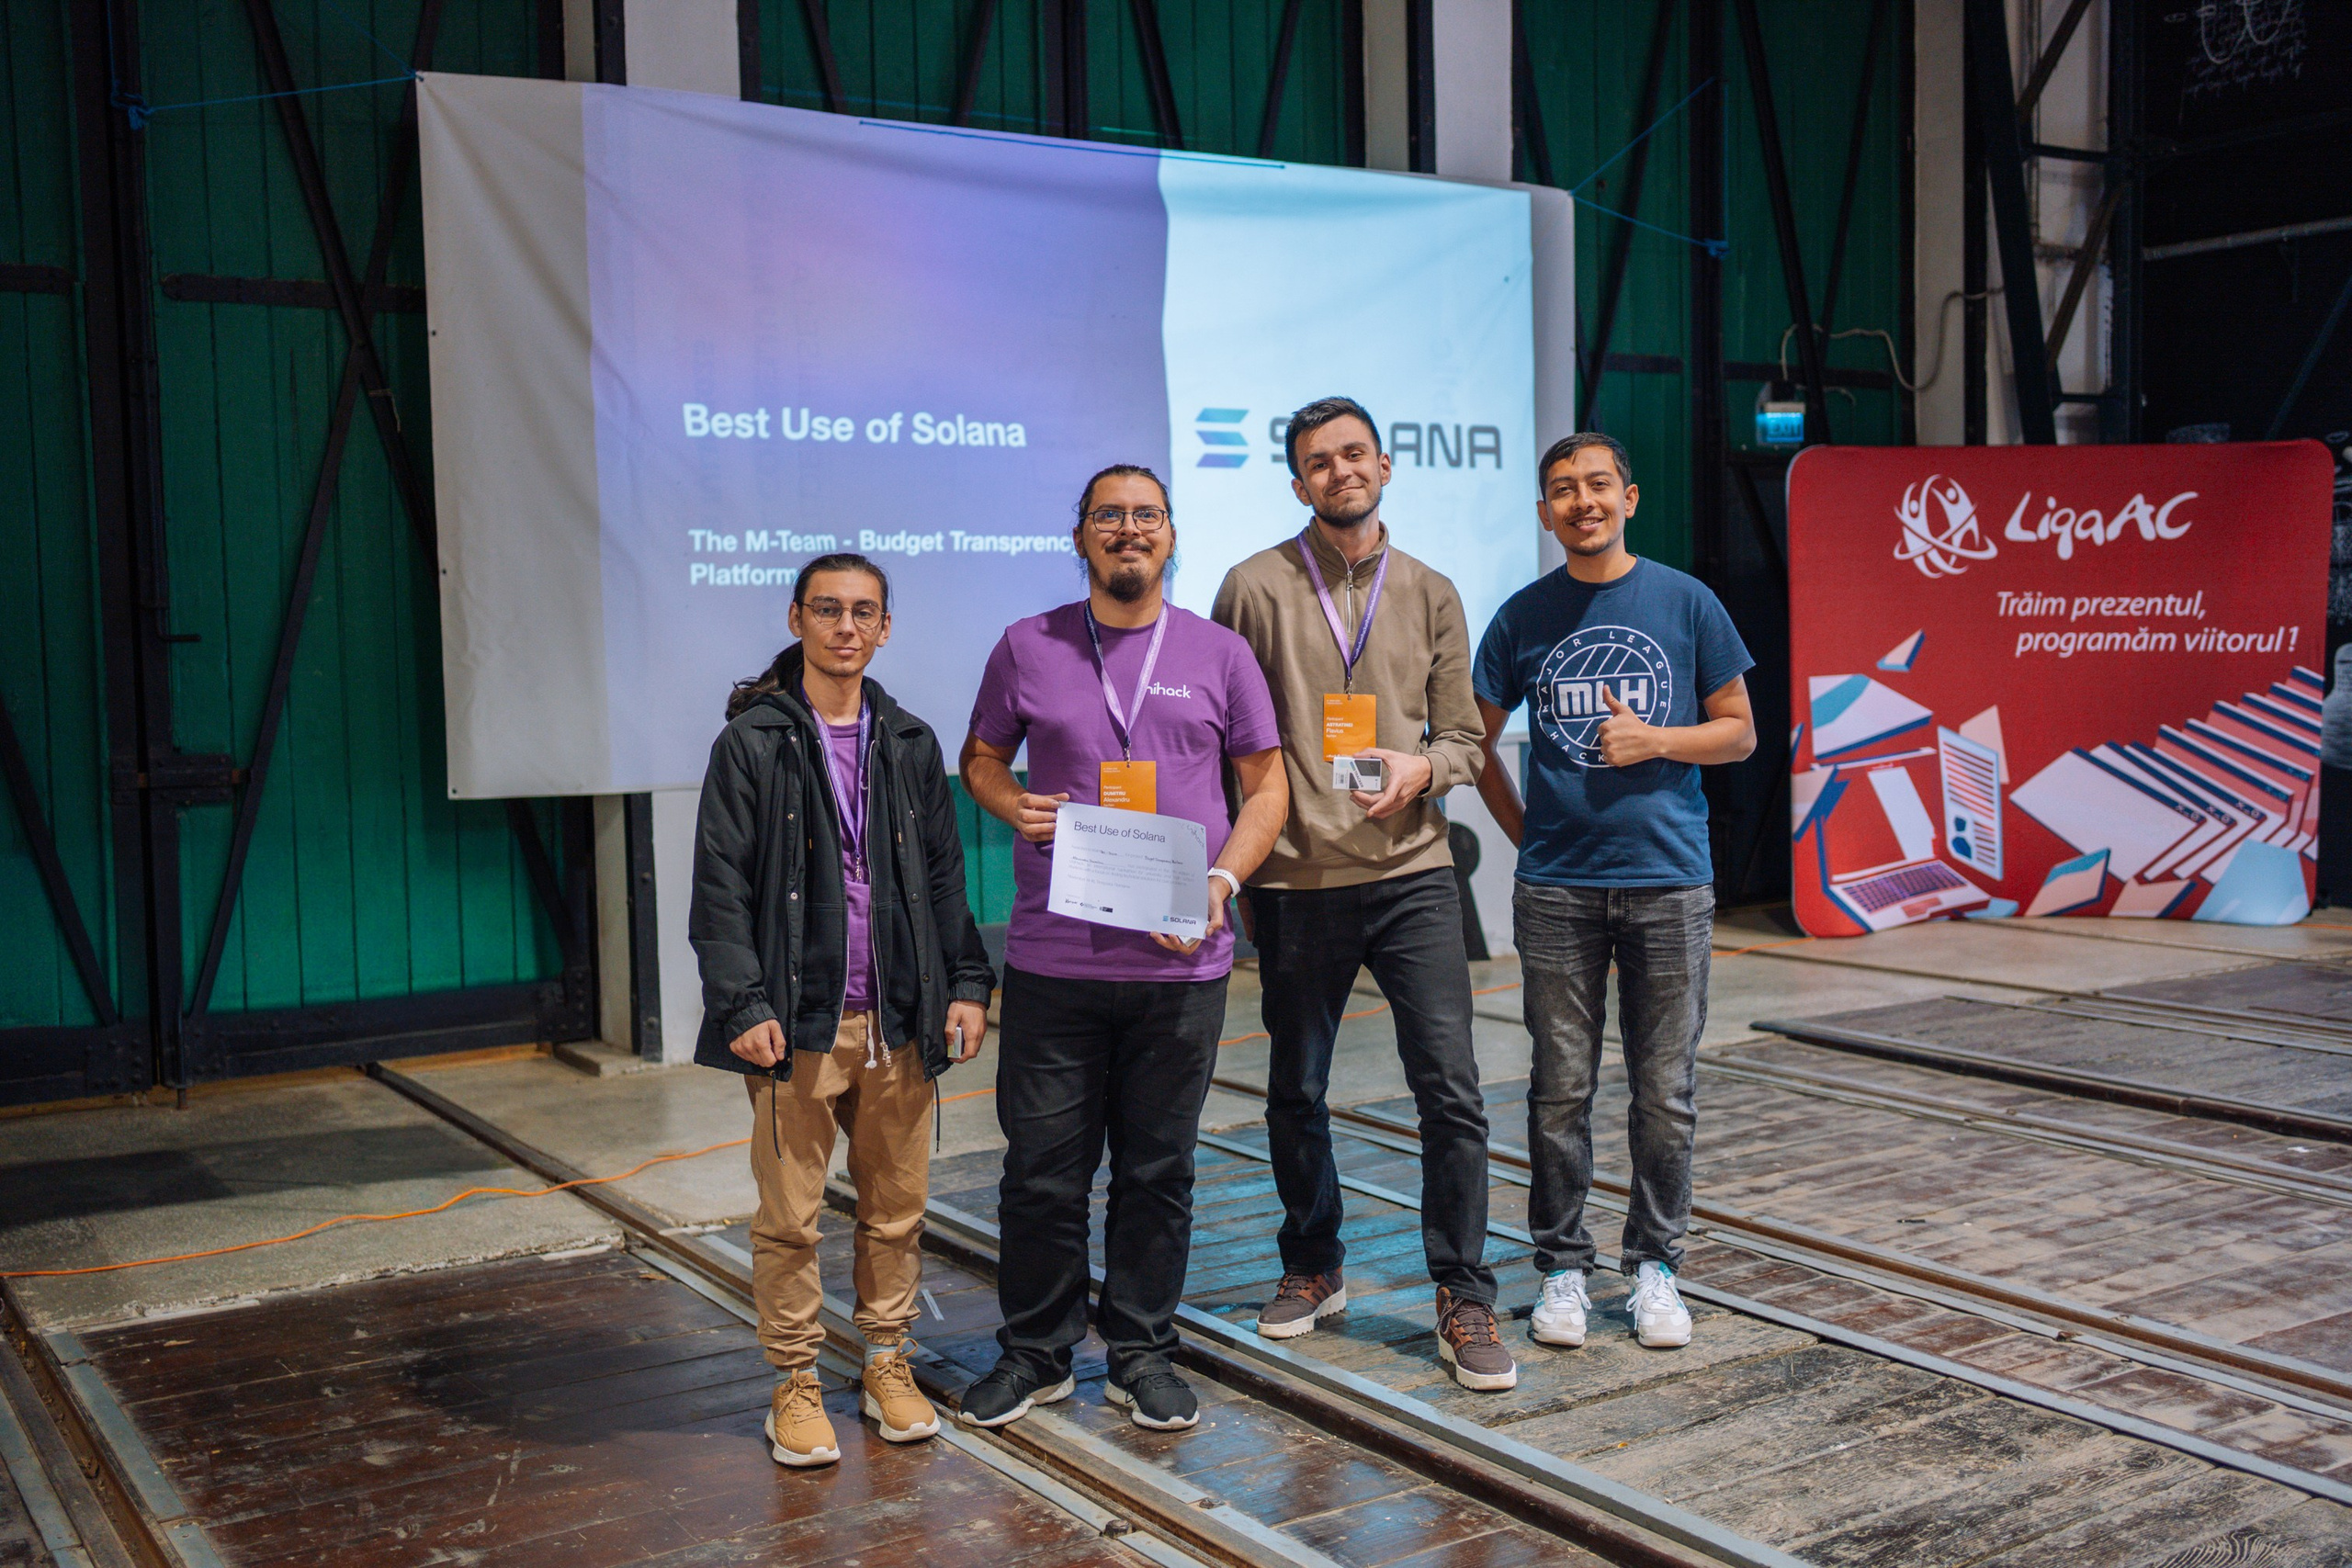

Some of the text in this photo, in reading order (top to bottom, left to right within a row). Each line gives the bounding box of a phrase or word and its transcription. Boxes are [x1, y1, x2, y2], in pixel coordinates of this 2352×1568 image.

[683, 402, 1027, 447] Best Use of Solana
[1269, 416, 1503, 469] SANA
[2005, 491, 2199, 560] LigaAC
[688, 529, 737, 552] The
[745, 530, 837, 553] M-Team
[859, 530, 944, 557] Budget
[690, 563, 798, 586] Platform
[1997, 590, 2206, 623] Trăim prezentul,
[2016, 626, 2177, 658] programăm
[1146, 682, 1192, 699] nihack
[1541, 630, 1668, 761] MAJOR LEAGUE HACK
[1557, 678, 1648, 716] MLH
[1074, 820, 1166, 843] Best Use of Solana
[1170, 916, 1197, 926] SOLANA
